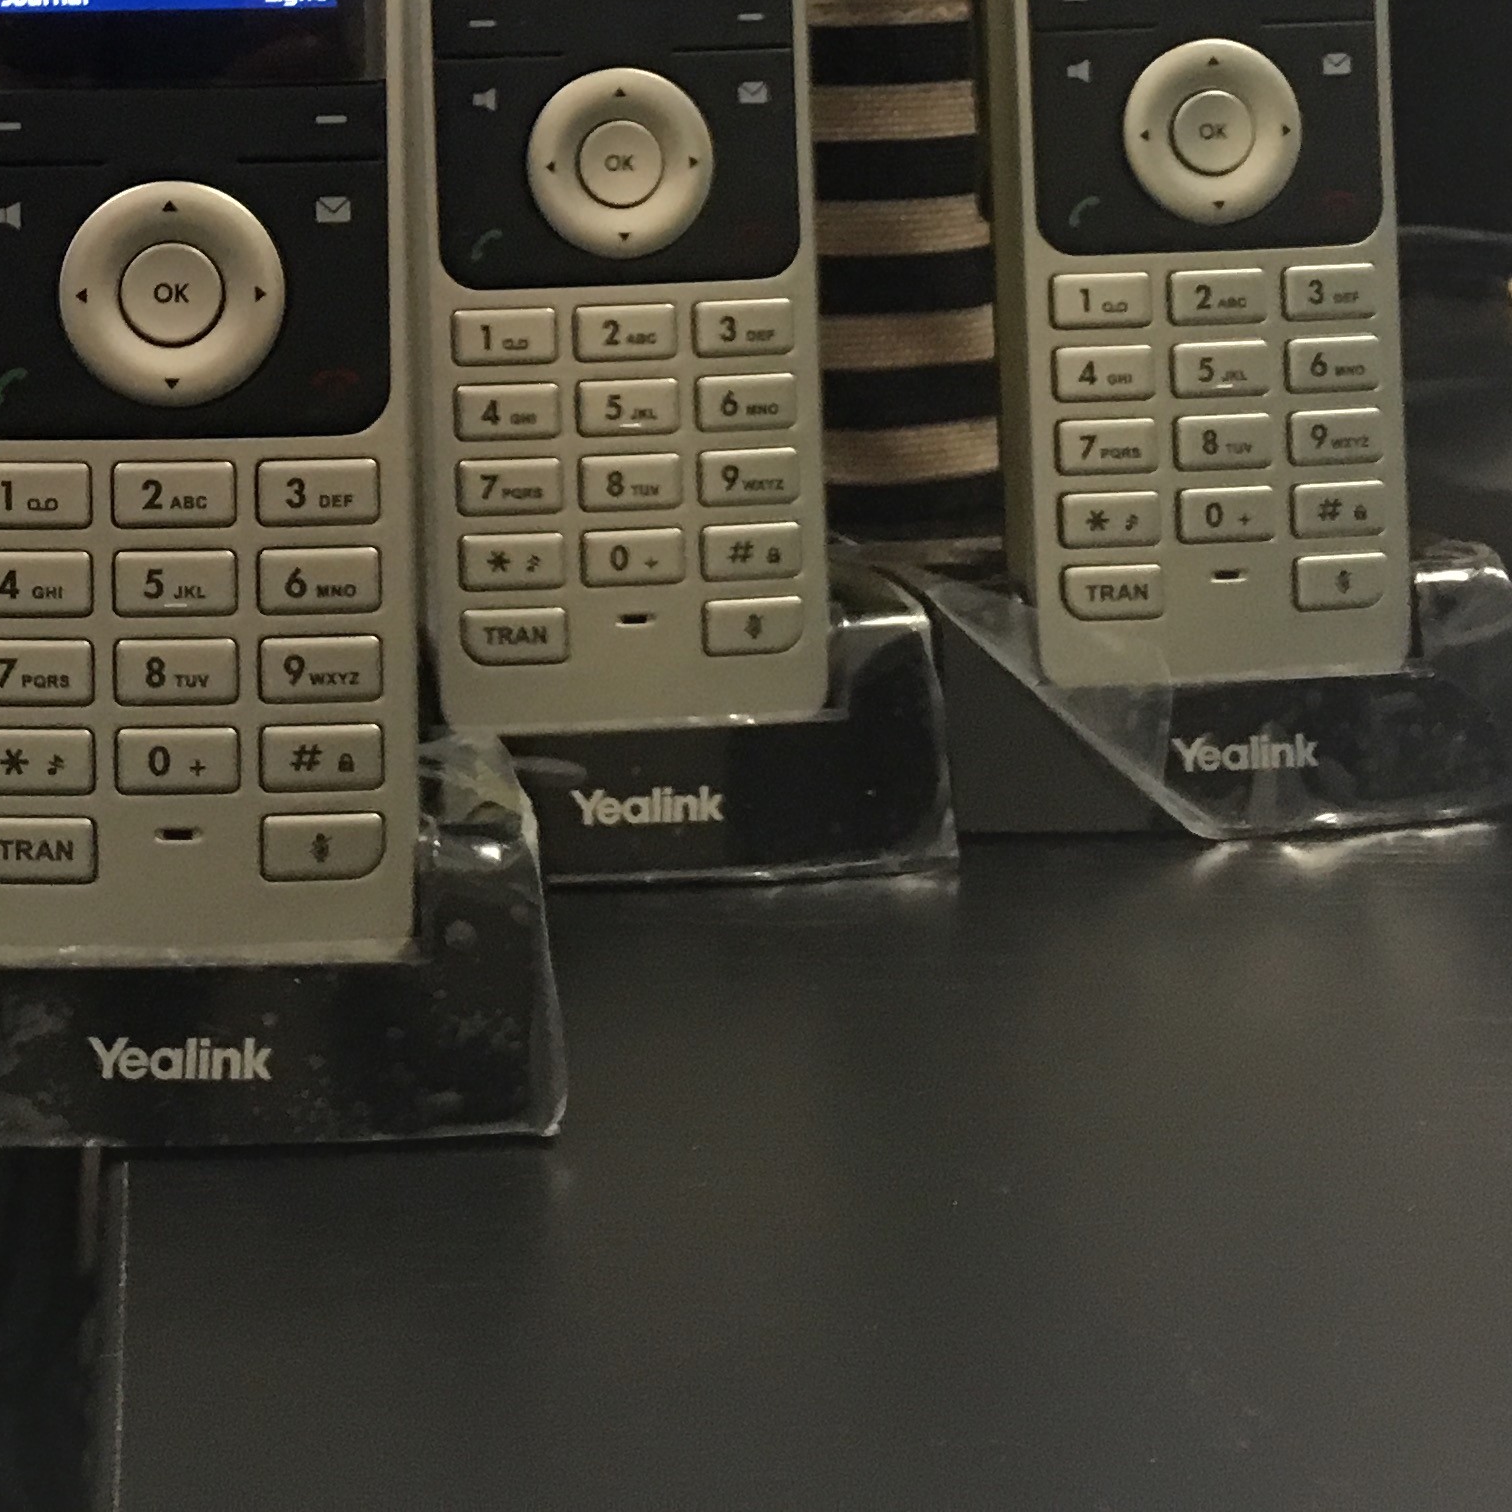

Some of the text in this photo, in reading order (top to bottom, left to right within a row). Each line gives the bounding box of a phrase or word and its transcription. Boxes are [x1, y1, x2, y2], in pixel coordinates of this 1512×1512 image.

[1199, 123, 1228, 140] OK
[605, 153, 634, 172] OK
[153, 282, 189, 304] OK
[1080, 288, 1091, 313] 1
[1195, 285, 1212, 310] 2
[1308, 280, 1323, 306] 3
[480, 325, 492, 350] 1
[602, 321, 620, 347] 2
[719, 317, 736, 342] 3
[1079, 360, 1096, 385] 4
[1198, 358, 1214, 383] 5
[1309, 352, 1327, 377] 6
[481, 400, 500, 425] 4
[605, 396, 622, 421] 5
[720, 392, 738, 417] 6
[1079, 434, 1098, 460] 7
[1201, 429, 1219, 455] 8
[1311, 424, 1328, 449] 9
[480, 475, 499, 500] 7
[606, 472, 625, 497] 8
[721, 466, 738, 492] 9
[0, 481, 14, 511] 1
[142, 479, 209, 510] 2 ABC
[286, 478, 353, 510] 3 DEF
[1205, 502, 1224, 528] 0
[610, 546, 629, 572] 0
[32, 585, 63, 600] GHI
[144, 569, 206, 600] 5 JKL
[285, 568, 356, 599] 6 MNO
[1085, 581, 1149, 604] TRAN
[484, 624, 547, 646] TRAN
[21, 673, 69, 689] PQRS
[144, 658, 209, 689] 8 TUV
[284, 655, 359, 687] 9 WXYZ
[148, 746, 171, 778] 0
[1172, 734, 1318, 774] Yealink
[570, 787, 723, 827] Yealink
[89, 1037, 272, 1082] Yealink
